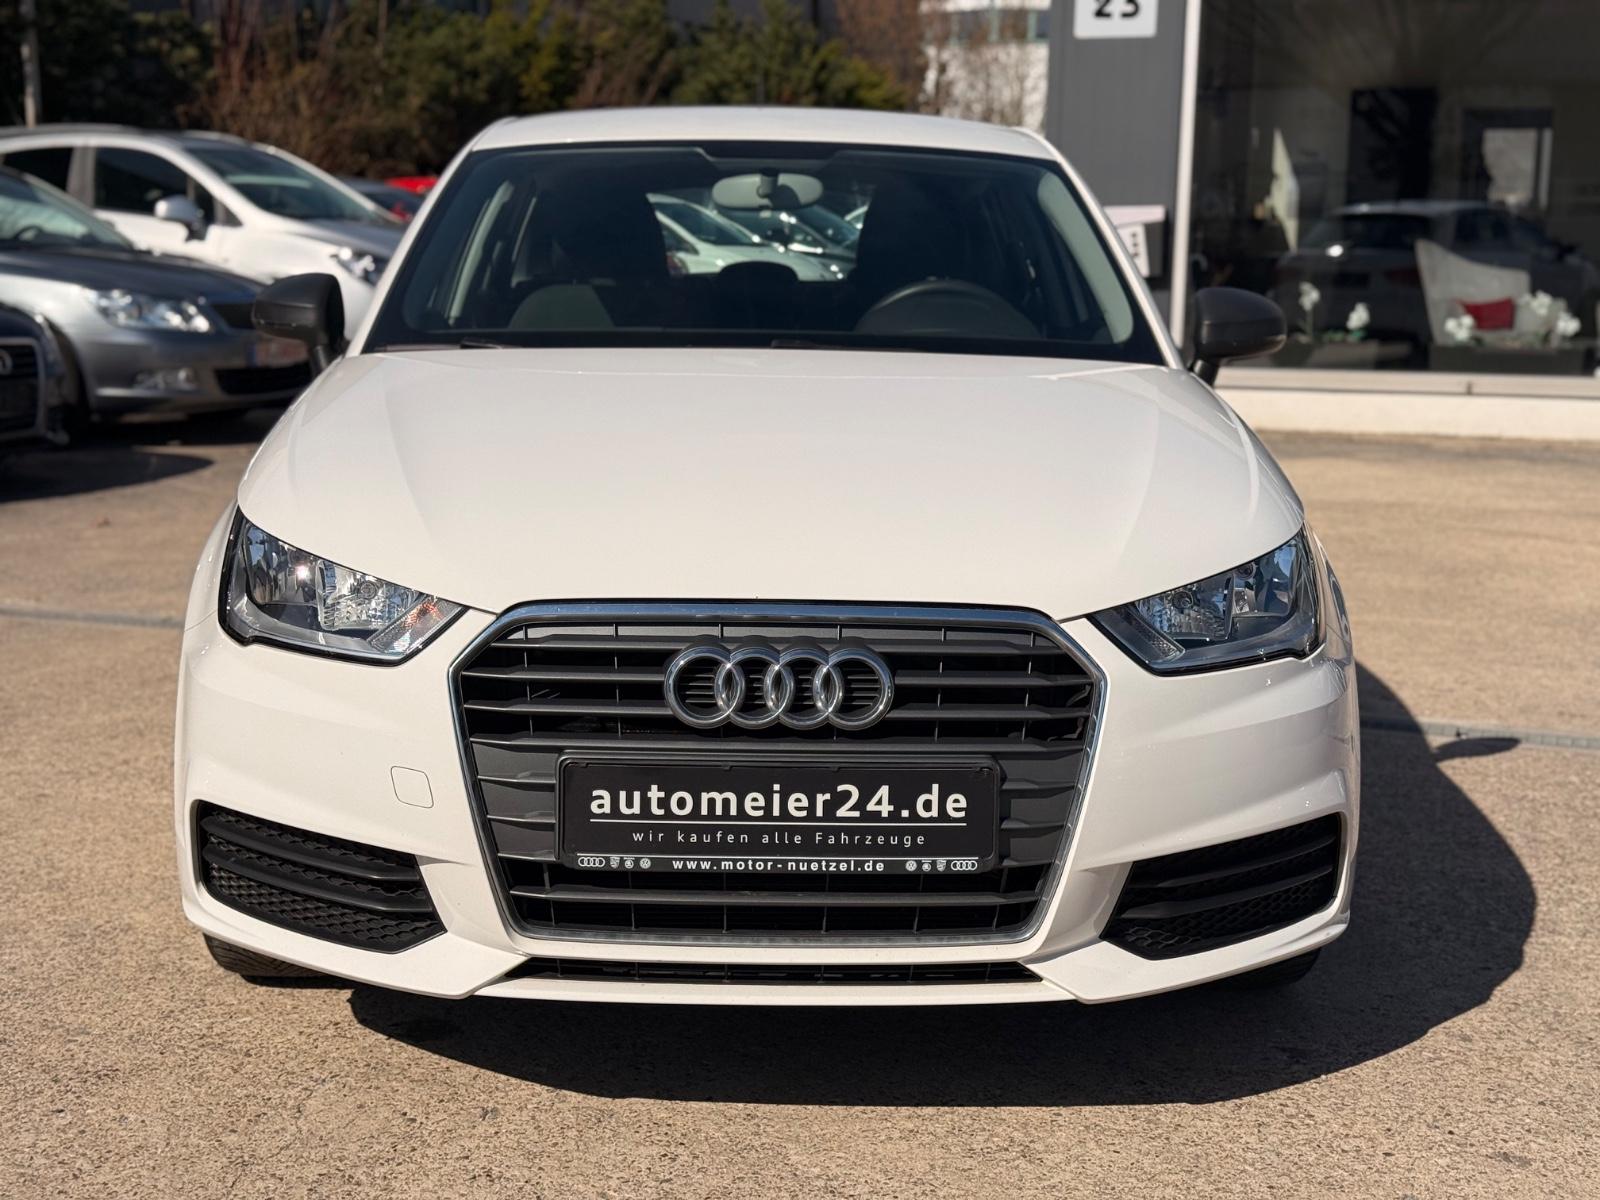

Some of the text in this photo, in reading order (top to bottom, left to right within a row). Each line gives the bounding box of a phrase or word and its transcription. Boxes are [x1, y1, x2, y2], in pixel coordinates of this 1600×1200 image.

[589, 783, 969, 819] automeier24.de
[632, 829, 926, 848] wir kaufen alle Fahrzeuge
[671, 858, 886, 873] www.motor-nuetzel.de
